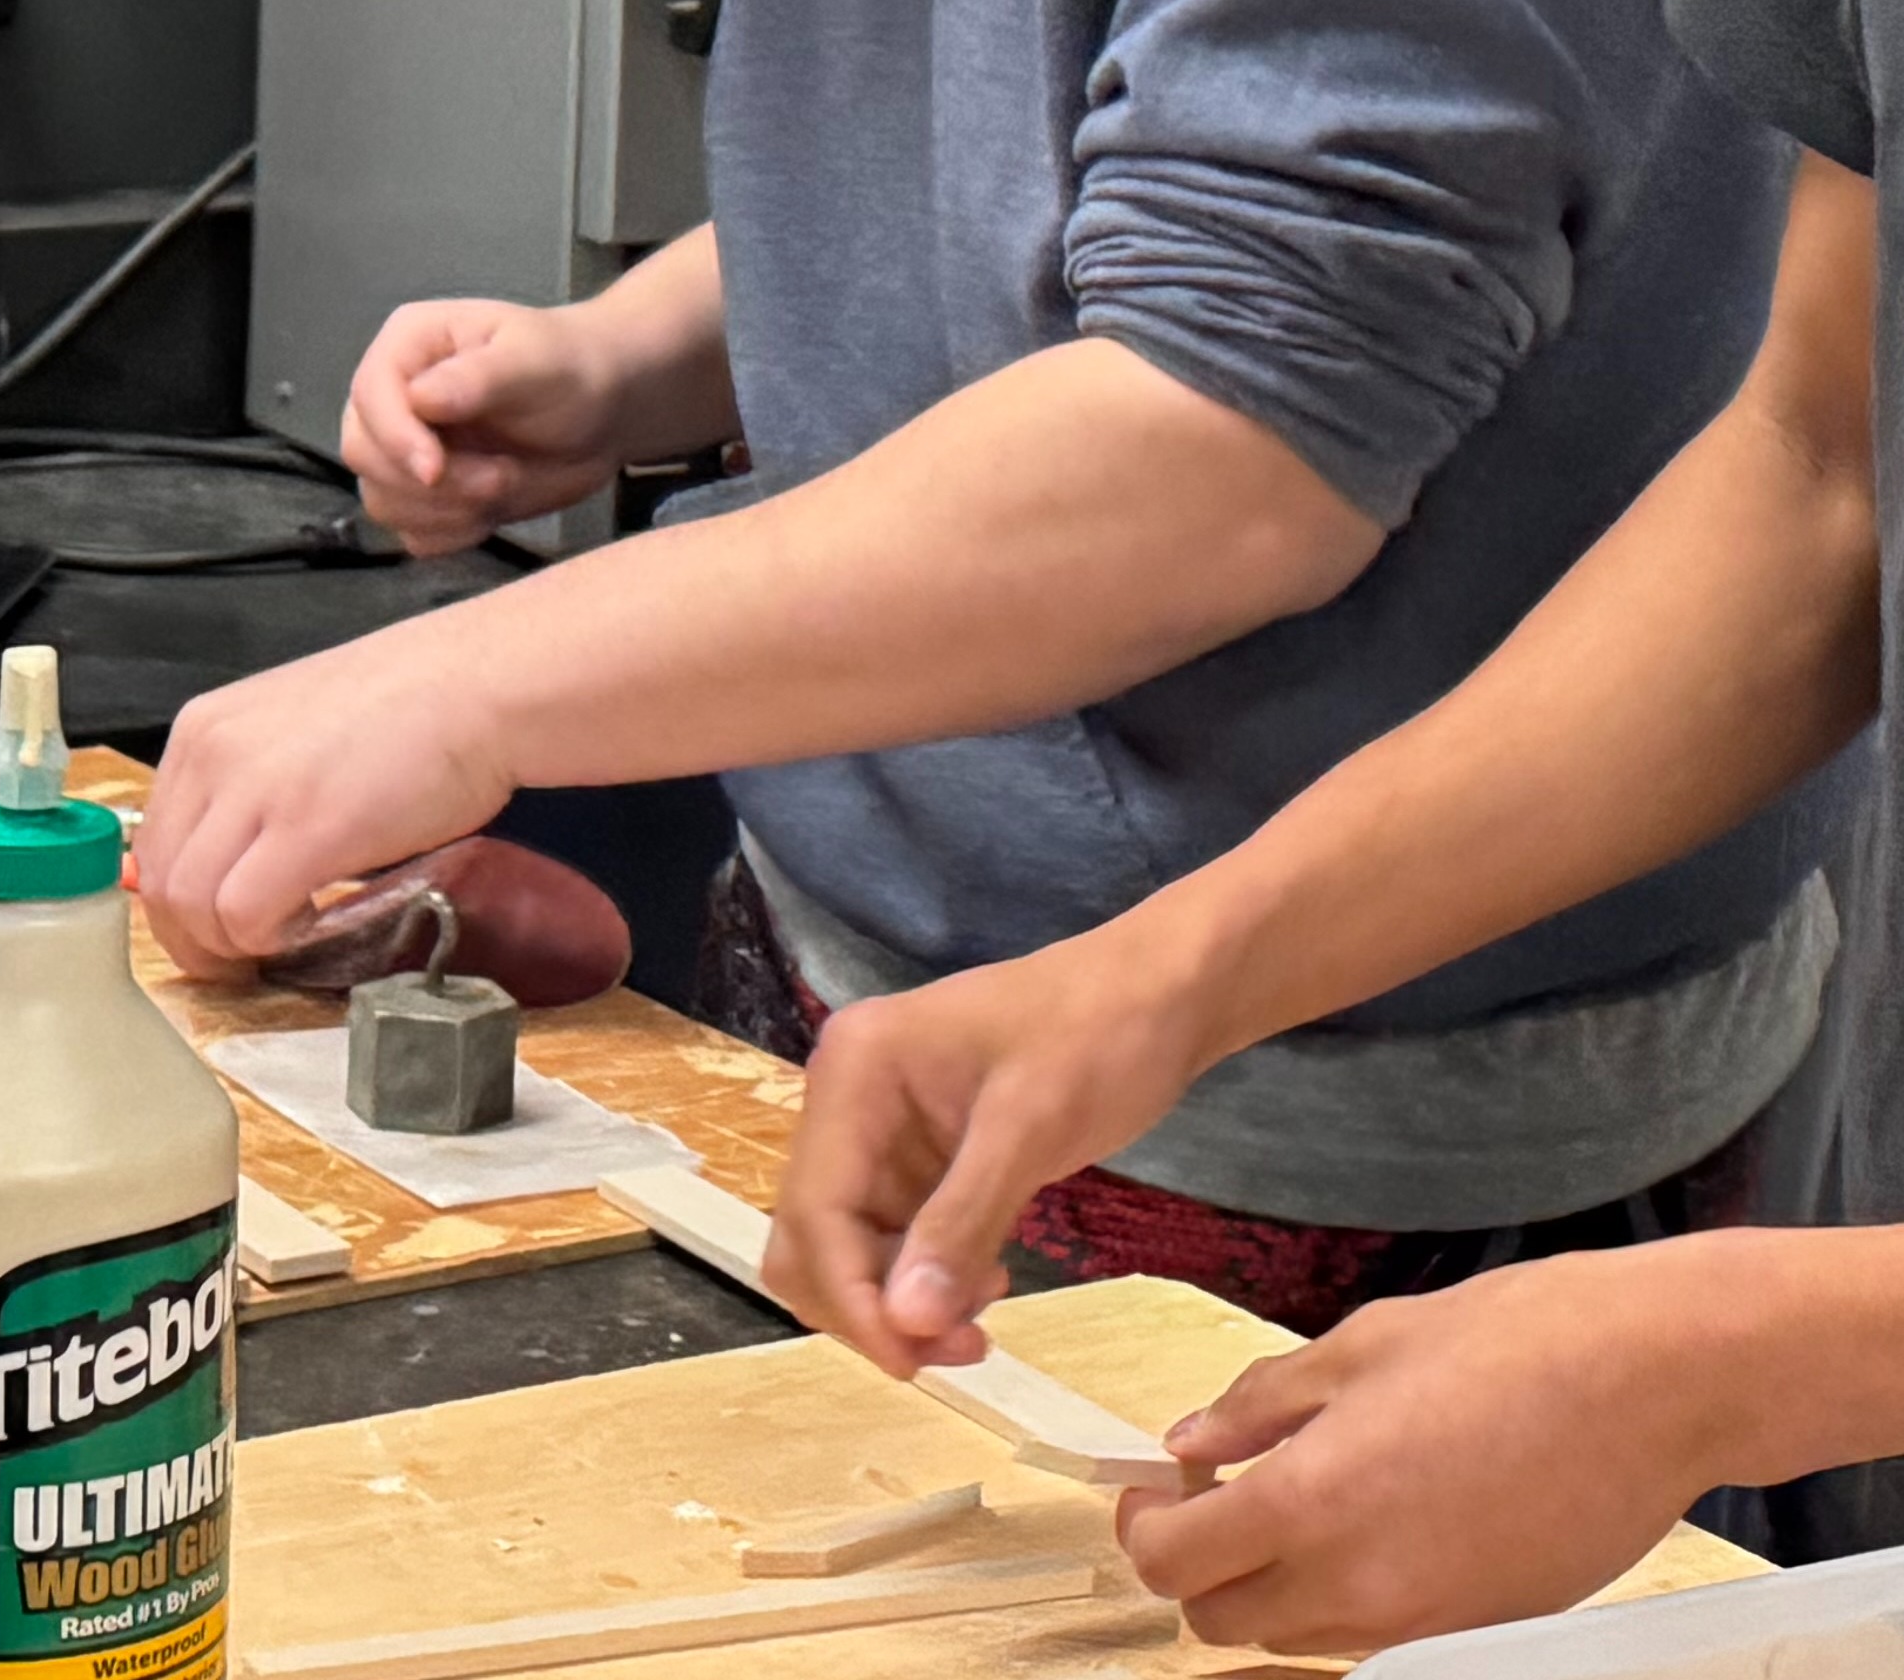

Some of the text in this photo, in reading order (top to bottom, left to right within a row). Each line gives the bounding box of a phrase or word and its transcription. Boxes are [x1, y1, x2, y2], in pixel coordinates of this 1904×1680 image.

[22, 1514, 229, 1611] Wood Glu
[60, 1604, 134, 1640] Rated
[137, 1598, 163, 1623] #1
[166, 1590, 190, 1615] By
[92, 1620, 207, 1679] Waterproof
